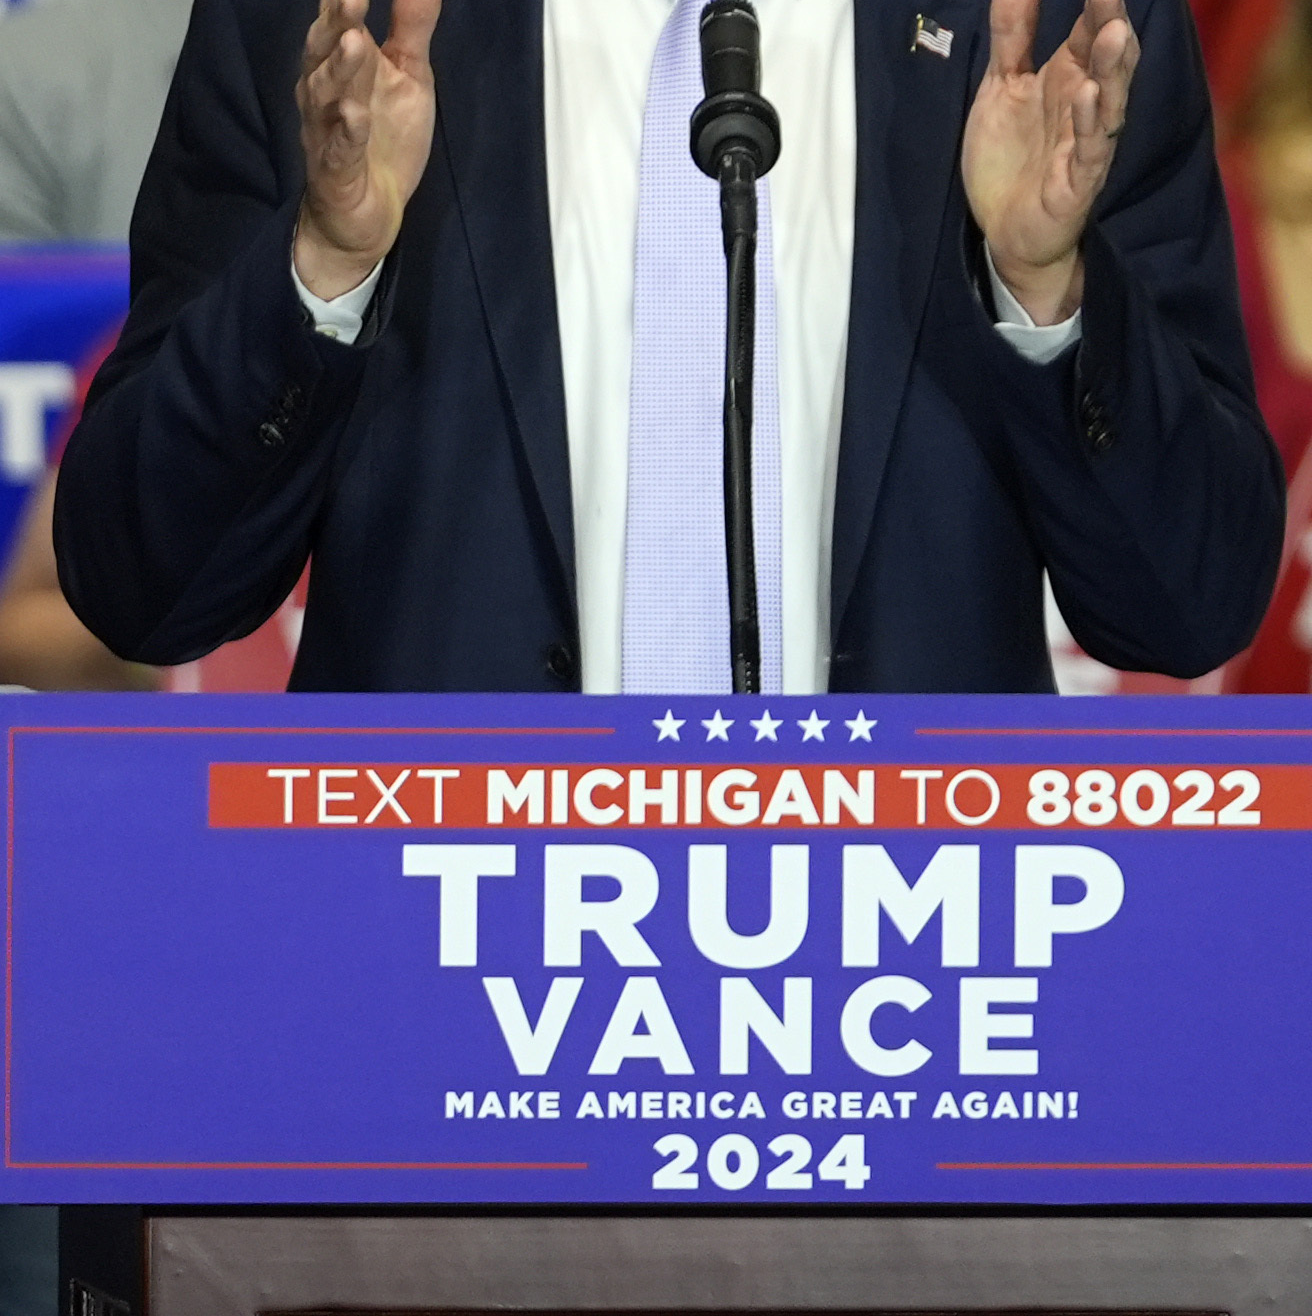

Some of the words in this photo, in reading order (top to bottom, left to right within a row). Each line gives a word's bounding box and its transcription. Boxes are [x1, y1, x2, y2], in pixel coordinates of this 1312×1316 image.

[267, 768, 460, 824] TEXT
[486, 768, 876, 826] MICHIGAN
[900, 769, 1001, 826] TO
[1025, 769, 1262, 826] 88022
[401, 844, 1126, 969] TRUMP
[481, 975, 1040, 1077] VANCE
[444, 1090, 561, 1119] MAKE
[575, 1090, 766, 1119] AMERICA
[782, 1090, 918, 1119] GREAT
[932, 1090, 1079, 1120] AGAIN!
[651, 1133, 871, 1191] 2024
